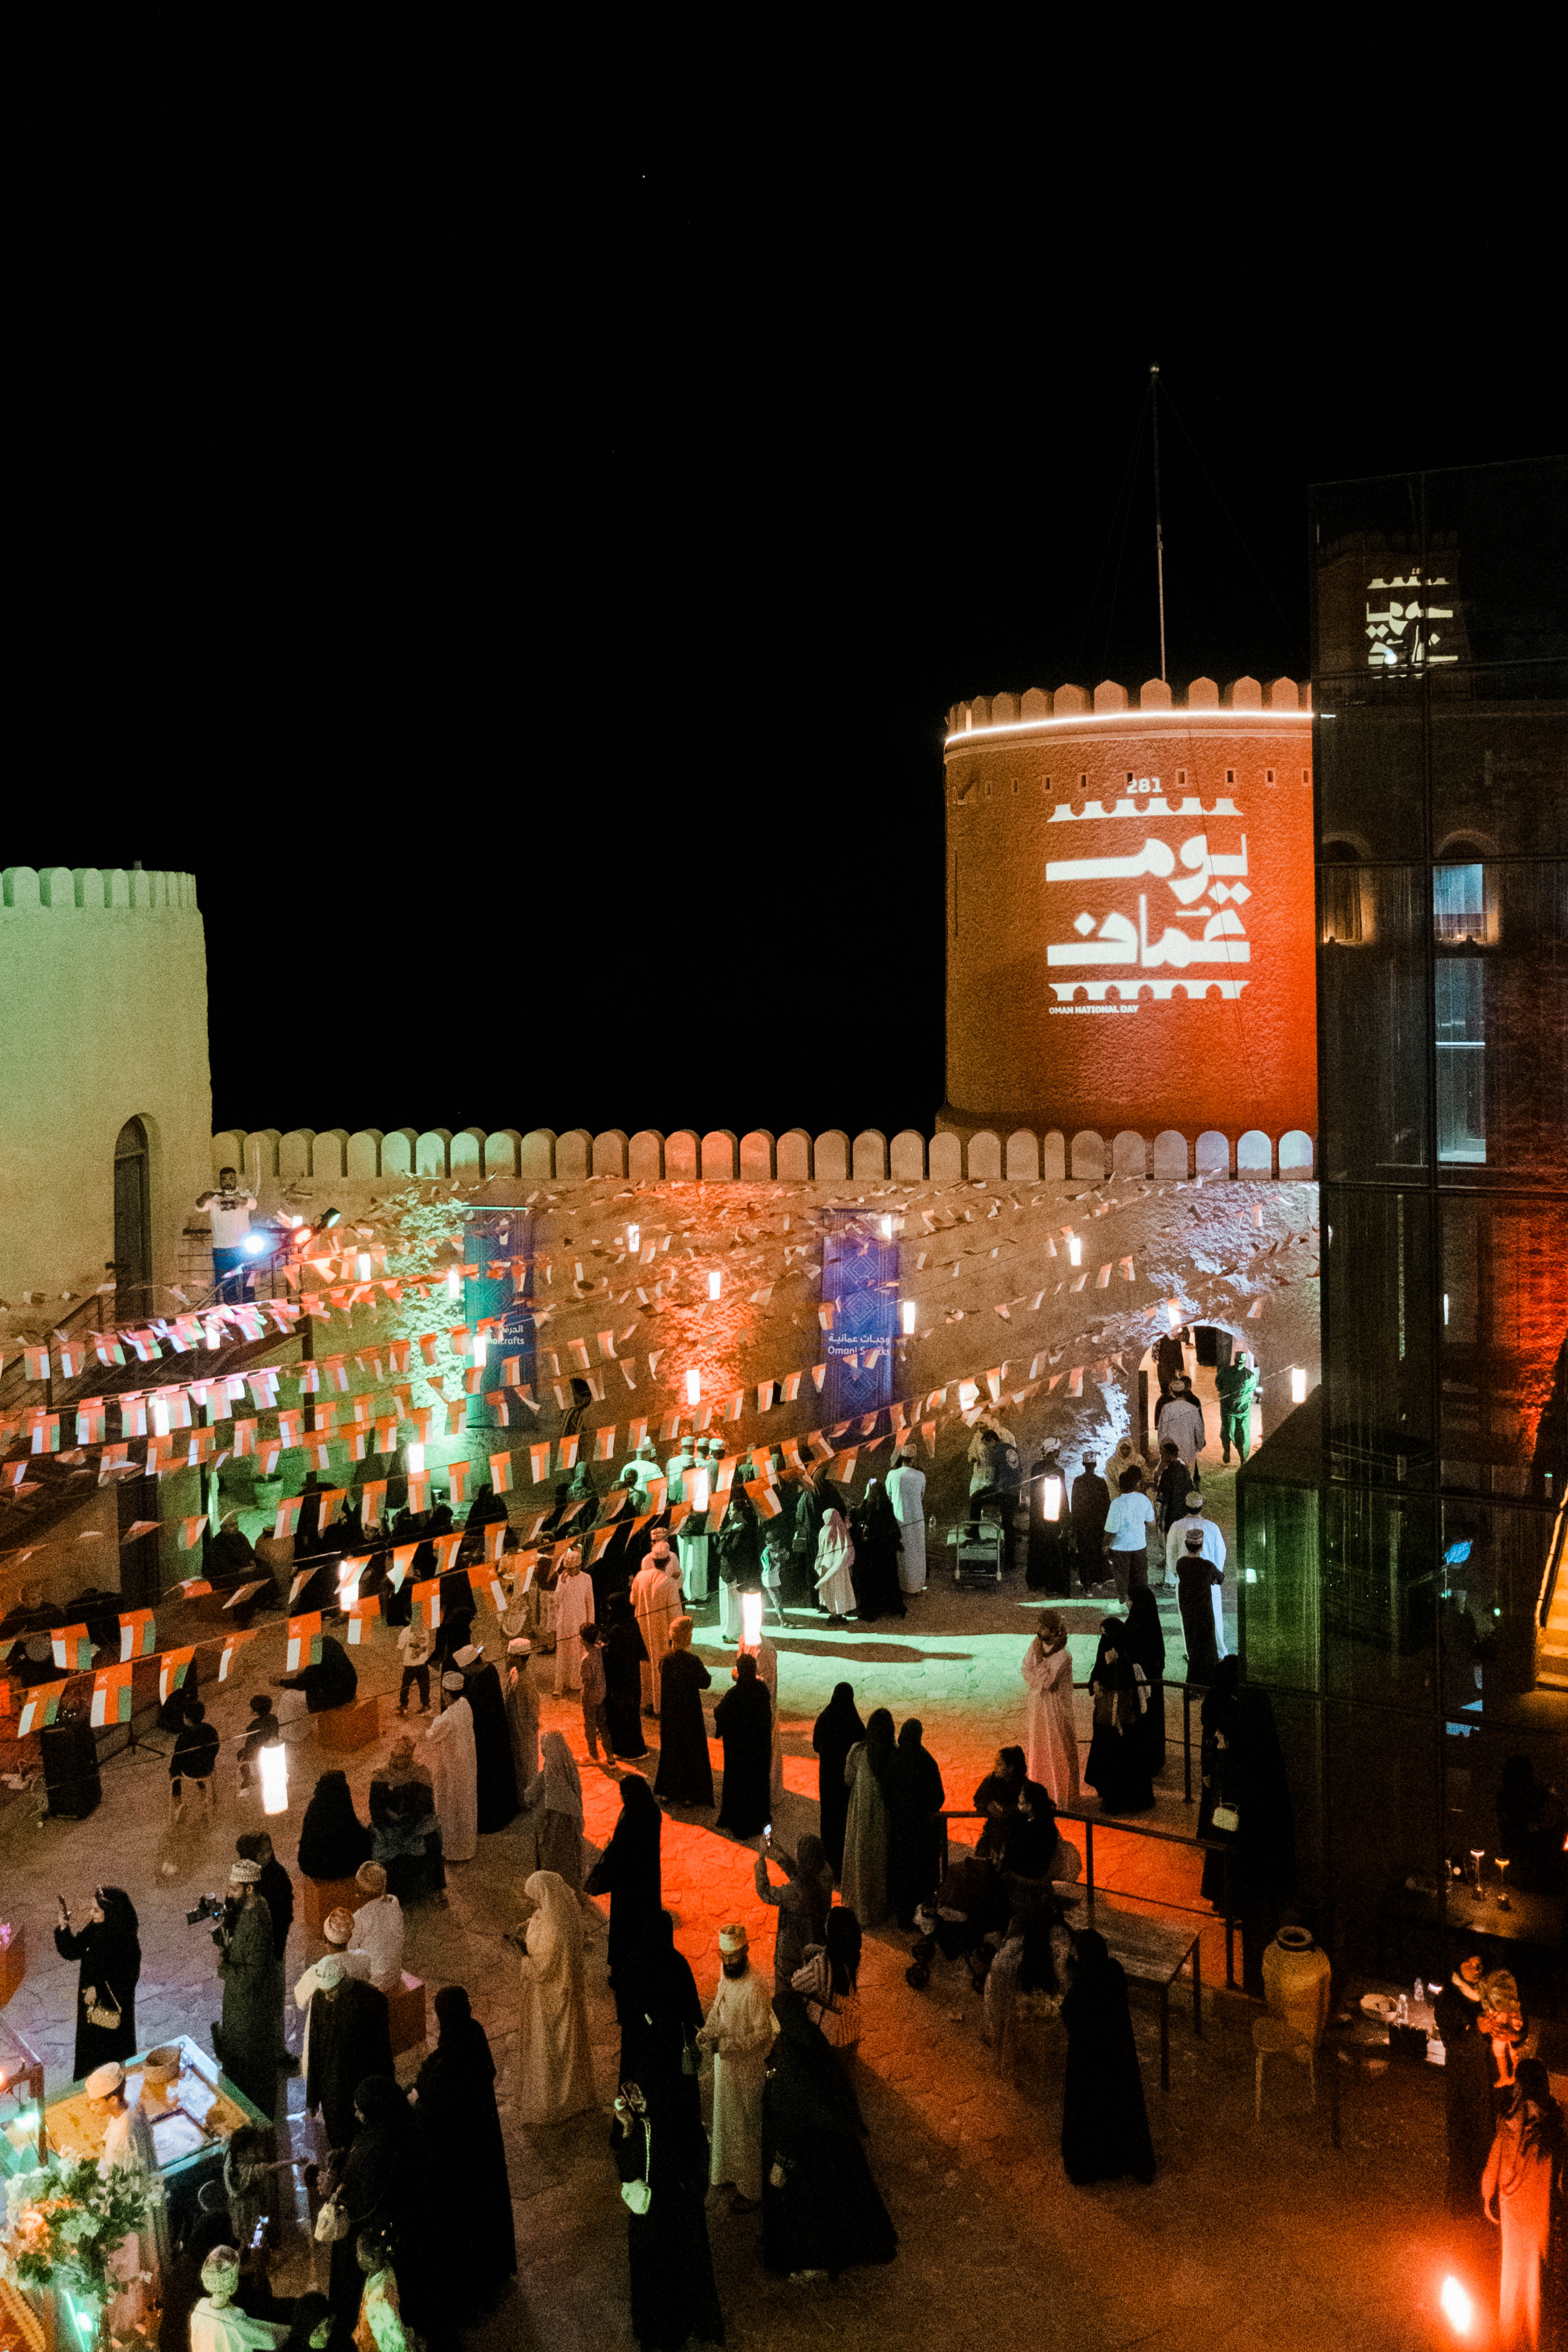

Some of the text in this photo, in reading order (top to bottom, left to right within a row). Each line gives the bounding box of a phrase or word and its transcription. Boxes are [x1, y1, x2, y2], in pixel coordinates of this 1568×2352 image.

[1127, 777, 1163, 794] 281
[1048, 1005, 1139, 1014] OMAN NATIONAL DAY
[828, 1333, 891, 1345] وجبات عمانية
[828, 1346, 891, 1355] Omani Sks
